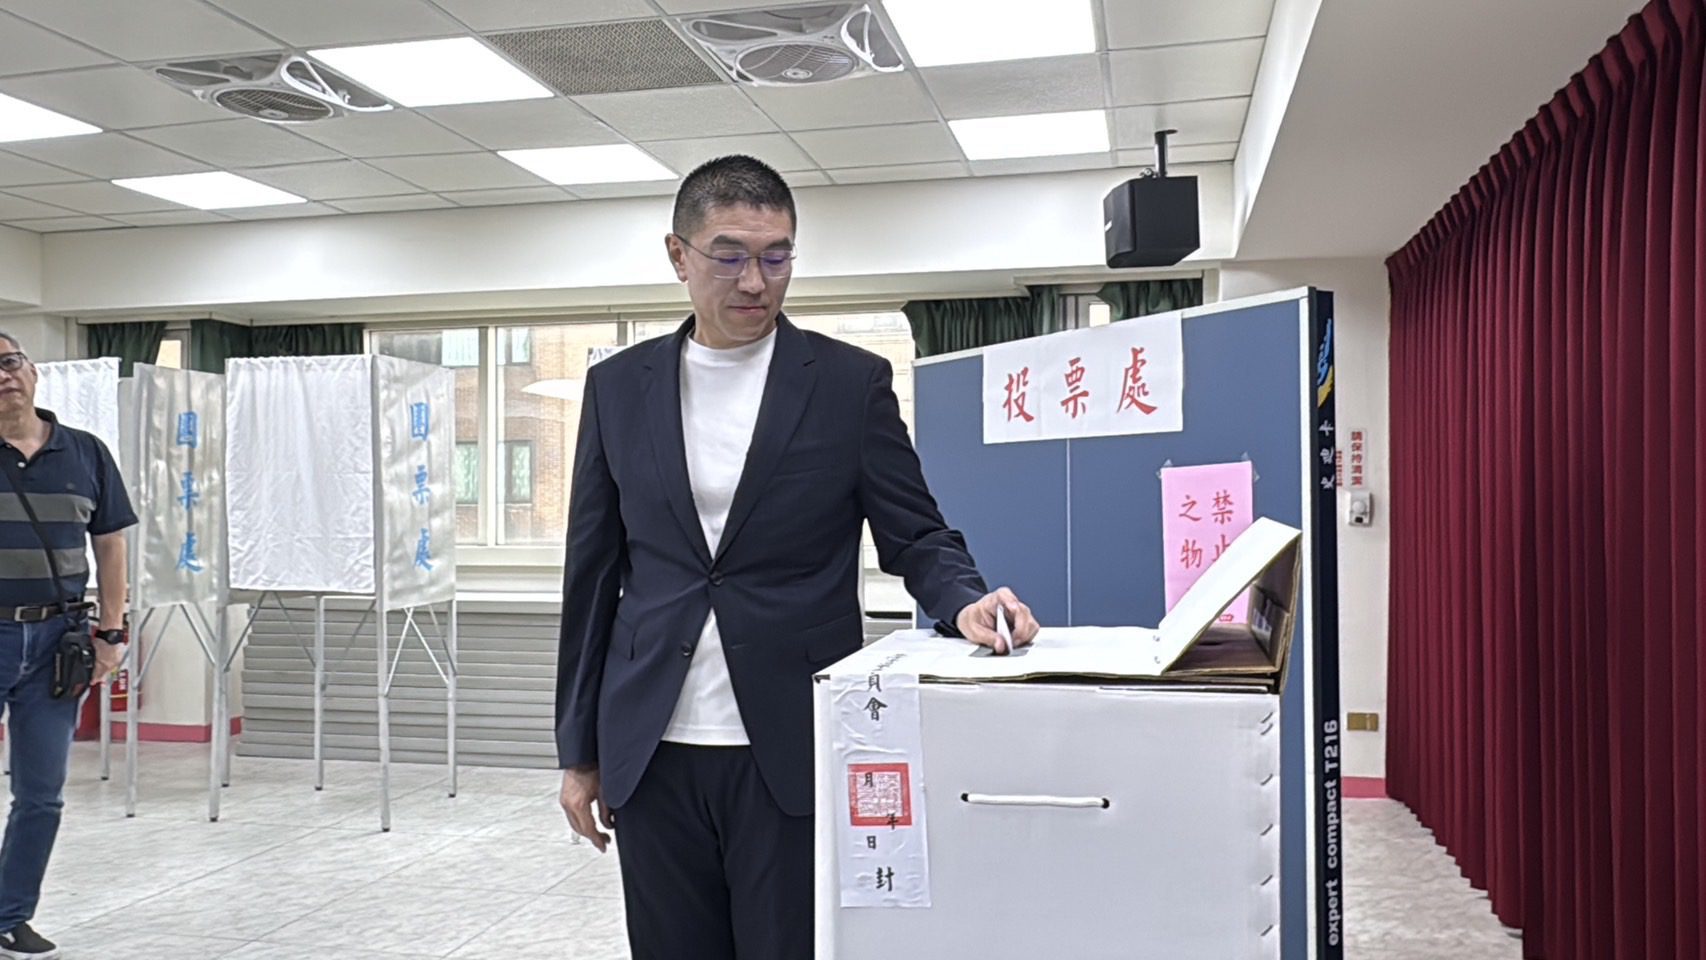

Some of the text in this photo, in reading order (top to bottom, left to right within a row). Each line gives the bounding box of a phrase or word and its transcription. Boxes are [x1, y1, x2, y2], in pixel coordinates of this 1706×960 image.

[1002, 346, 1158, 423] 投票處
[1178, 494, 1203, 570] 之物
[1324, 719, 1341, 947] expert compact T216
[875, 866, 895, 892] 封
